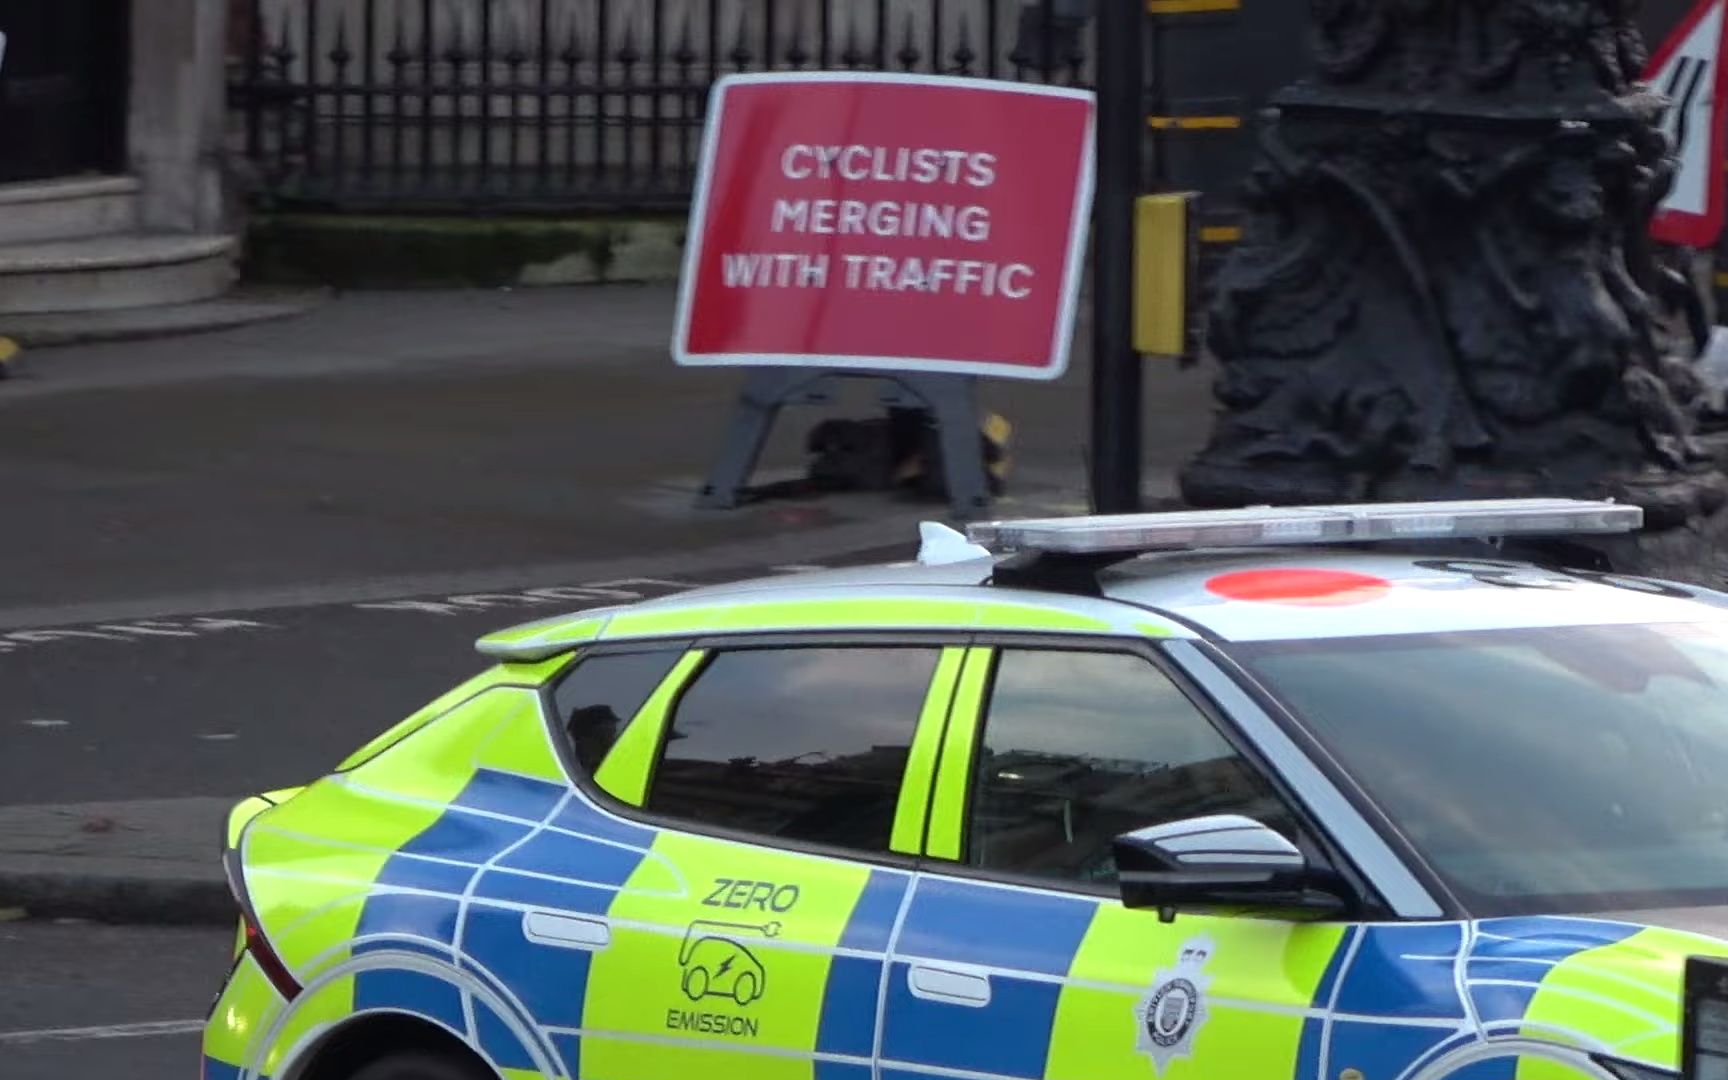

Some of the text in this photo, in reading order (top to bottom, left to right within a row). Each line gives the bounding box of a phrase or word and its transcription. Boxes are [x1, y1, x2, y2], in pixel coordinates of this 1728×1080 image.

[780, 144, 997, 187] CYCLISTS
[770, 199, 990, 241] MERGING
[721, 253, 1034, 300] WITH TRAFFIC
[701, 878, 800, 912] ZERO
[666, 1008, 759, 1037] EMISSION
